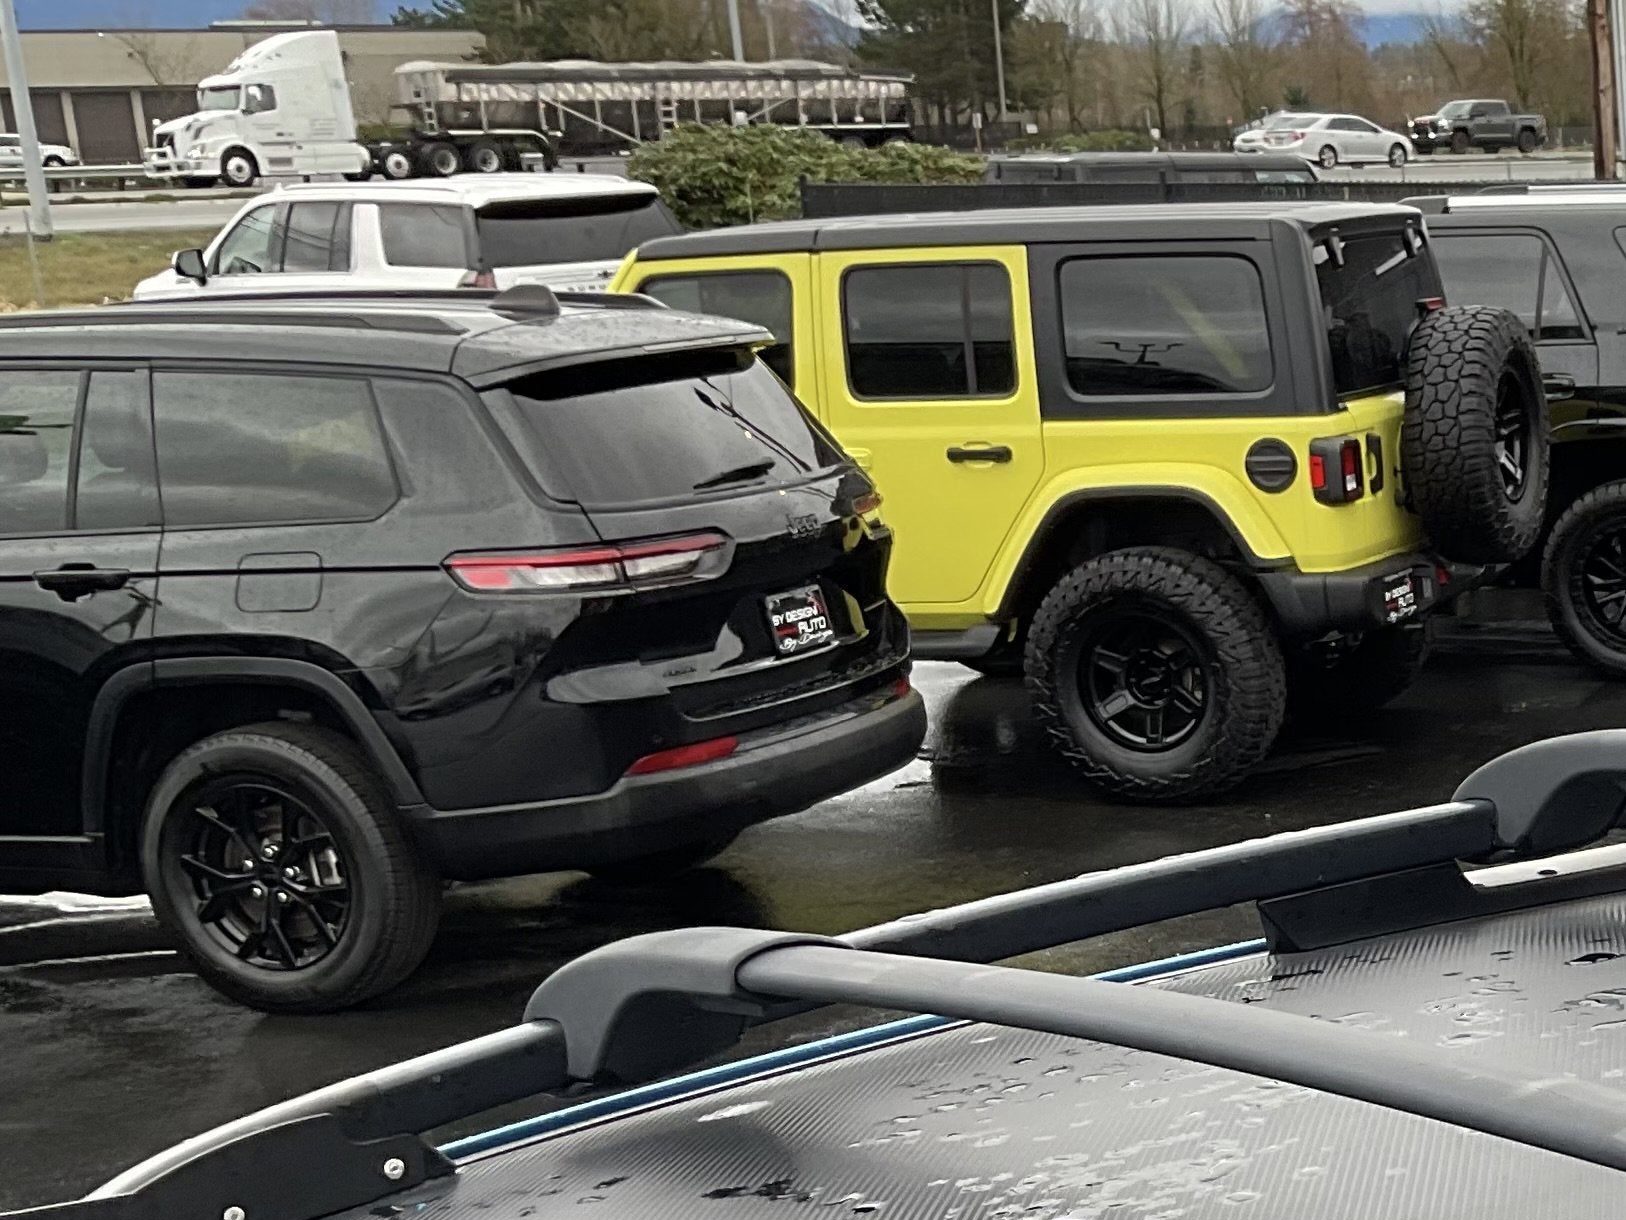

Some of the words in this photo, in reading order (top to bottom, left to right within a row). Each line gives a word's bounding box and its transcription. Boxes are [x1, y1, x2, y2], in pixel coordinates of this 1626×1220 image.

[772, 614, 784, 626] BY
[786, 606, 818, 623] DESIGN
[798, 616, 826, 634] AUTO
